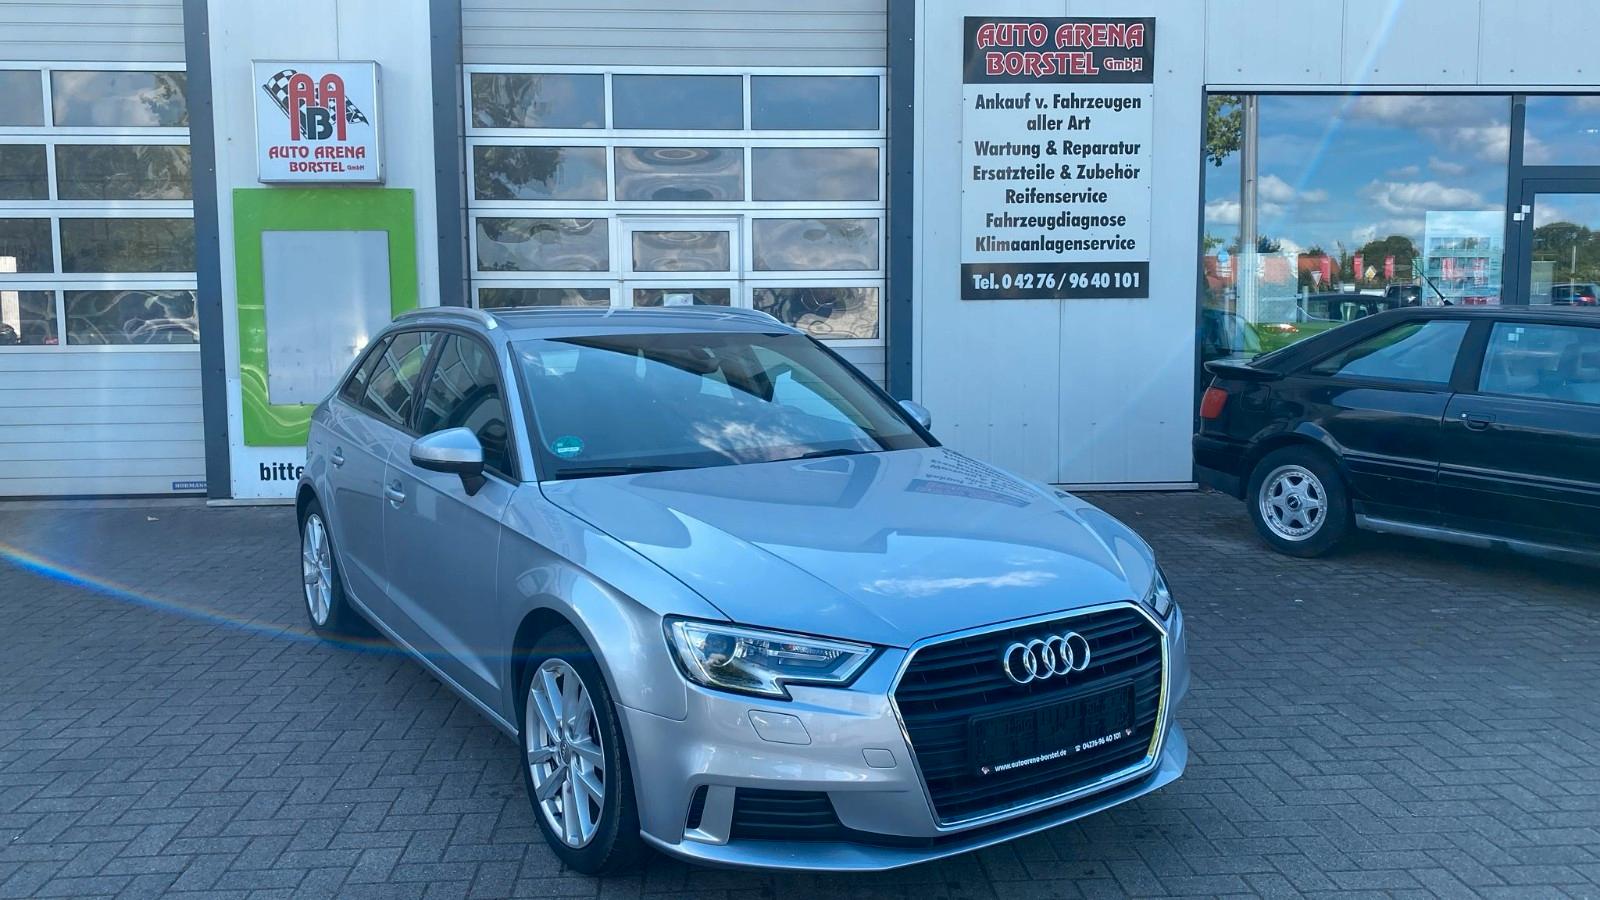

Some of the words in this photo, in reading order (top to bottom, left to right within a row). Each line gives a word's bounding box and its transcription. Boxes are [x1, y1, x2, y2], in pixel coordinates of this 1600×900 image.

[977, 23, 1048, 49] AUTO
[1055, 23, 1144, 49] ARENA
[986, 52, 1099, 77] BORSTEL
[1103, 57, 1143, 72] GmbH
[975, 93, 1031, 110] Ankauf
[1035, 98, 1048, 109] v.
[1053, 92, 1141, 112] Fahrzeugen
[1027, 114, 1063, 131] aller
[1068, 115, 1091, 130] Art
[268, 146, 309, 159] AUTO
[314, 146, 366, 159] ARENA
[974, 140, 1041, 158] Wartung
[1046, 140, 1058, 156] &
[1063, 140, 1141, 158] Reparatur
[289, 162, 345, 173] BORSTEL
[973, 163, 1055, 181] Ersatzteile
[1060, 164, 1071, 180] &
[1076, 163, 1141, 180] Zubehör
[1005, 187, 1108, 204] Reifenservice
[986, 211, 1126, 230] Fahrzeugdiagnose
[975, 234, 1136, 254] Klimaanlagenservice
[973, 273, 999, 290] Tel.
[1114, 272, 1140, 288] 101
